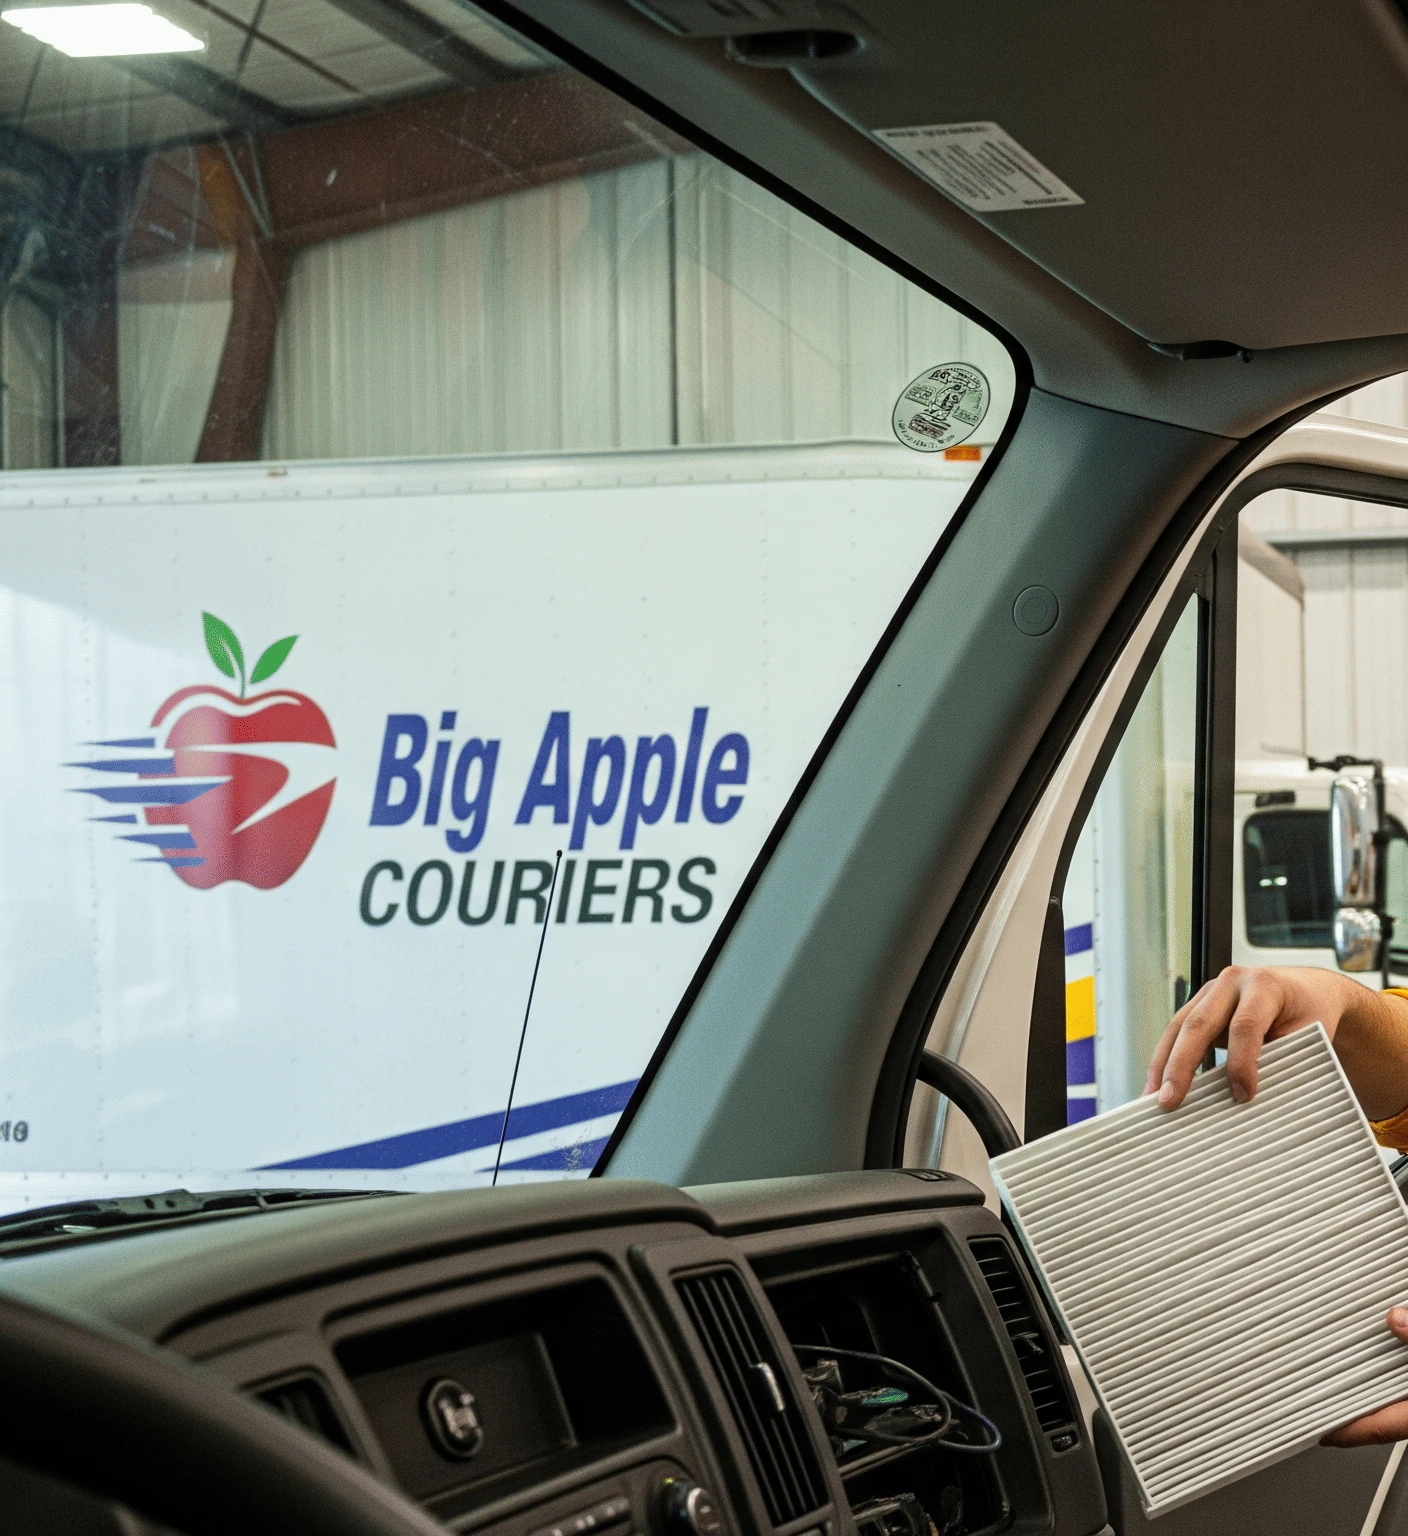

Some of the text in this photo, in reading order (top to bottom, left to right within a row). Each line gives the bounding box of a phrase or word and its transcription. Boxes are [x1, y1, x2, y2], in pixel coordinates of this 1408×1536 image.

[368, 706, 751, 855] Big Apple
[359, 856, 717, 927] COURIERS
